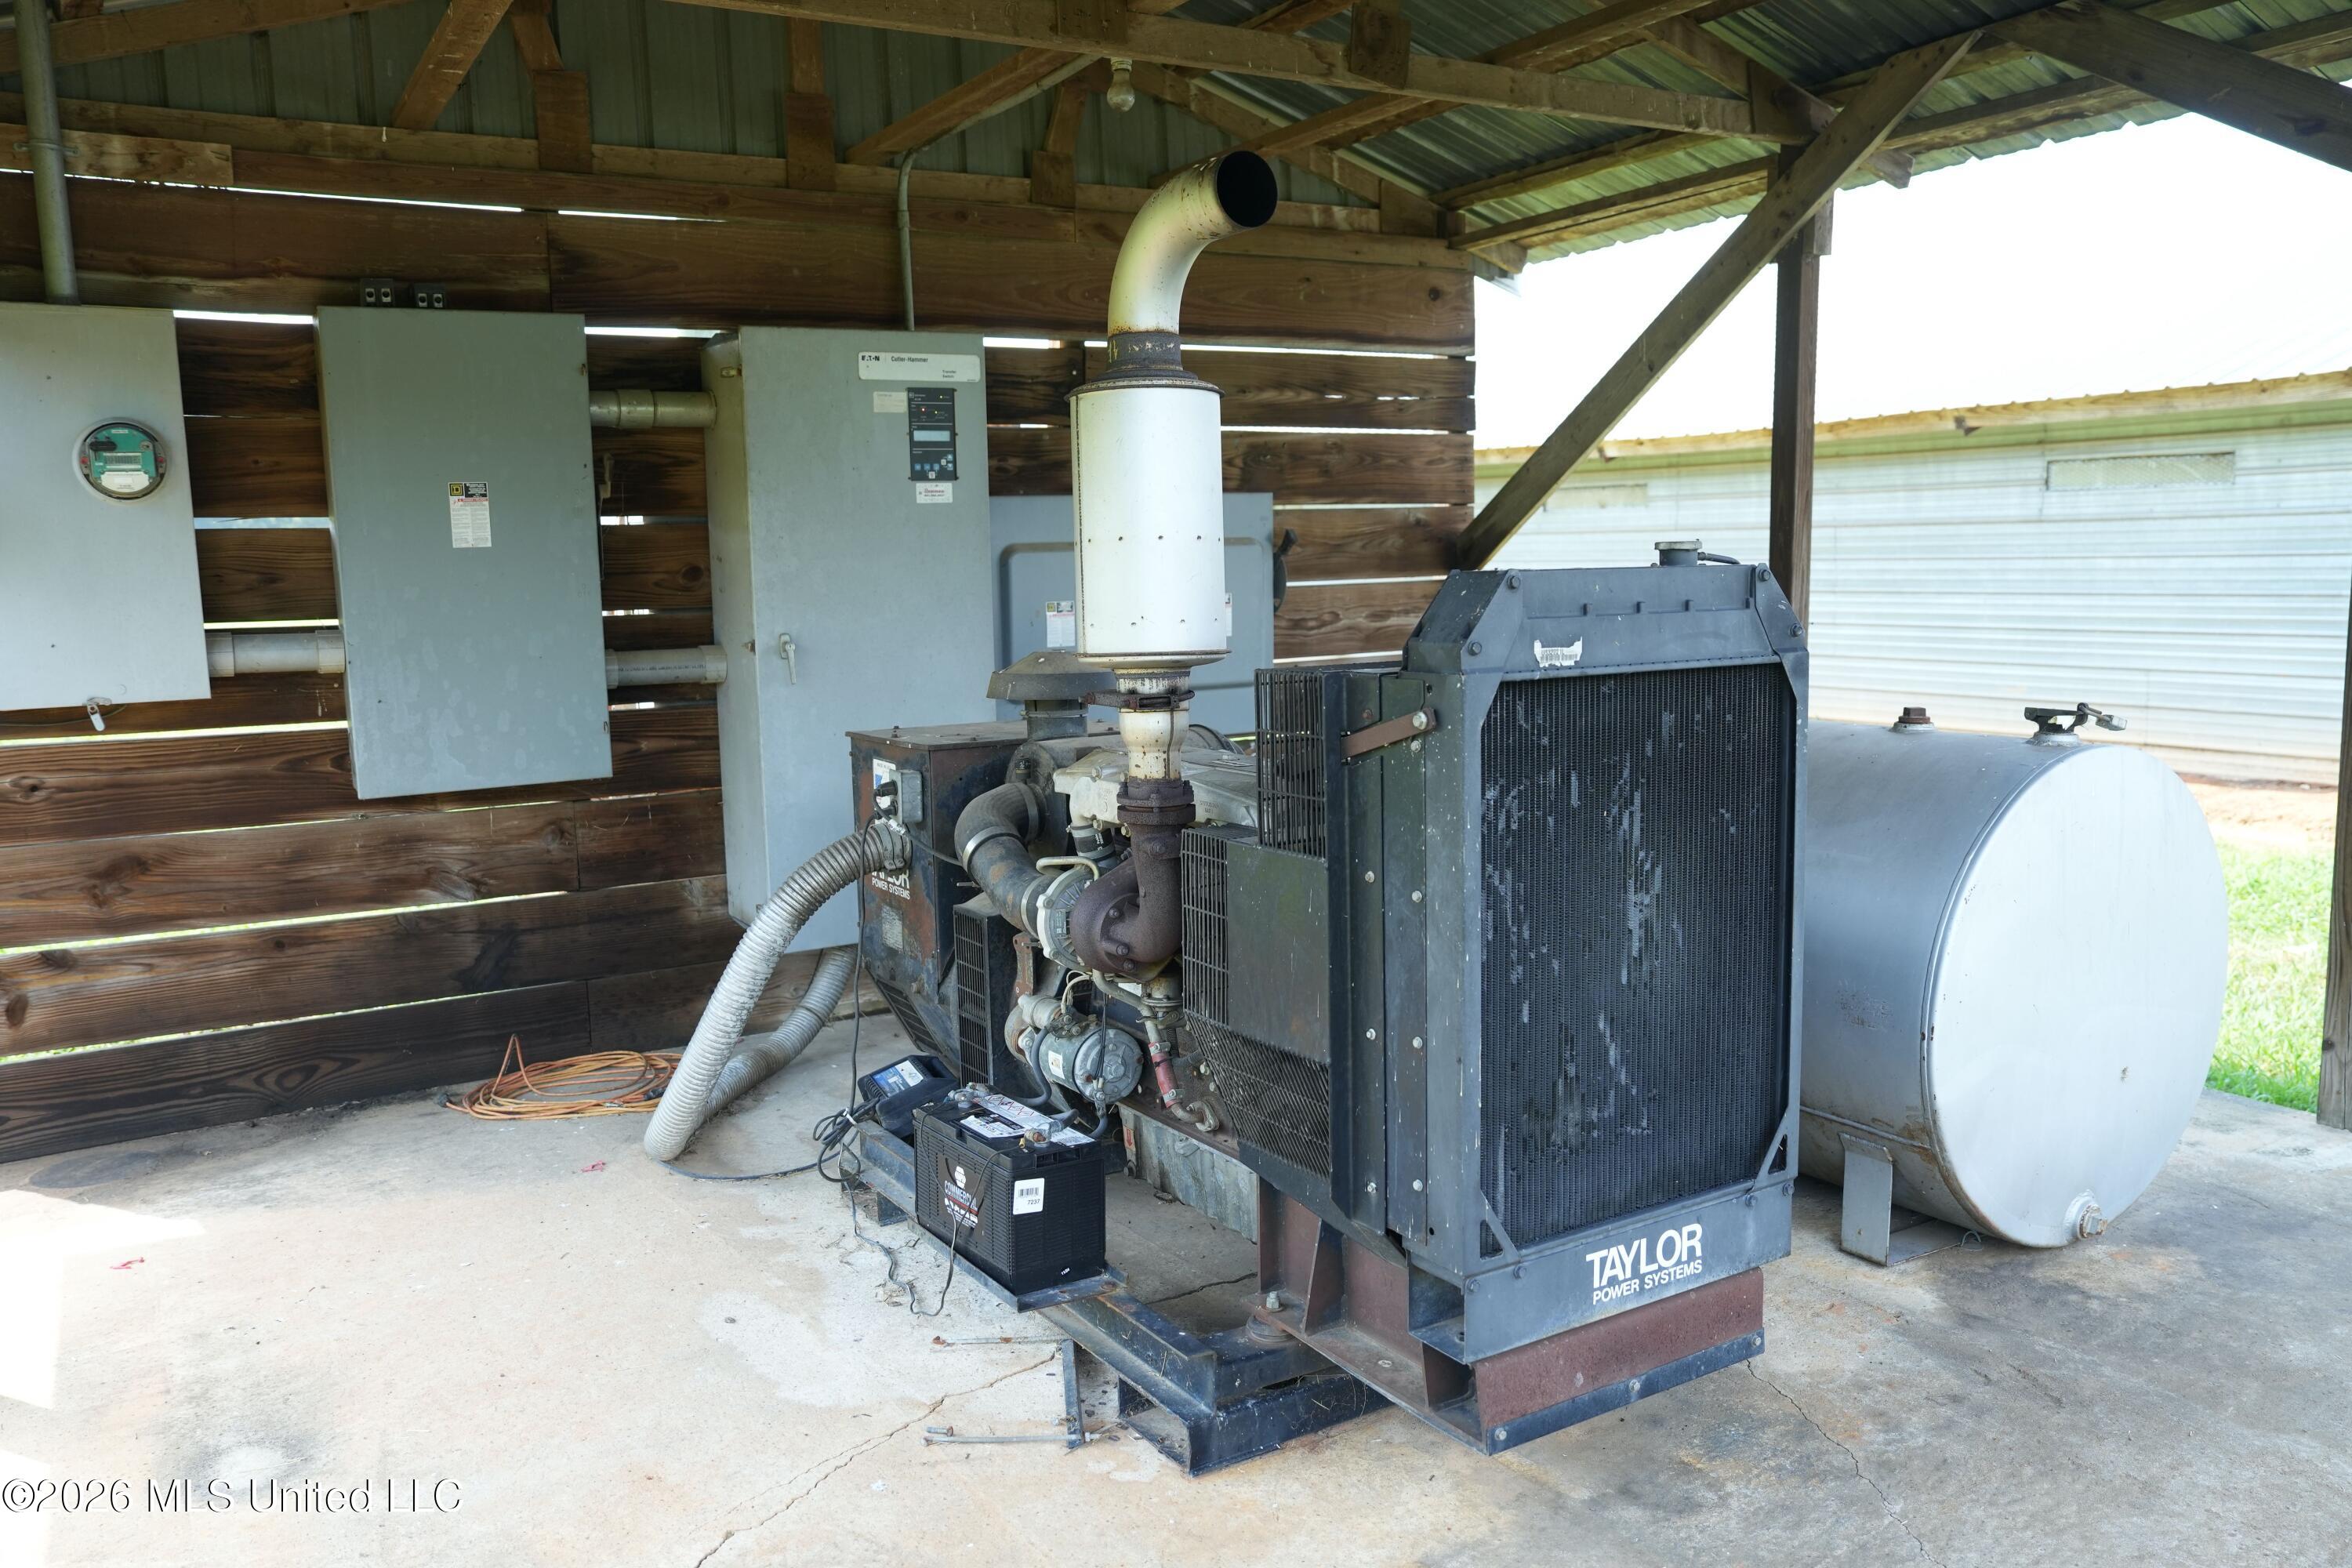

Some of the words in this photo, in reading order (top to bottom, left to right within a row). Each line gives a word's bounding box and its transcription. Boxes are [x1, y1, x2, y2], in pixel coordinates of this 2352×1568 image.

[872, 877, 888, 891] POWER
[888, 883, 910, 900] SYSTEMS
[944, 1180, 978, 1211] COMMERCIAL
[1586, 1223, 1703, 1290] TAYLOR
[1592, 1279, 1640, 1305] POWER
[1644, 1259, 1703, 1290] SYSTEMS
